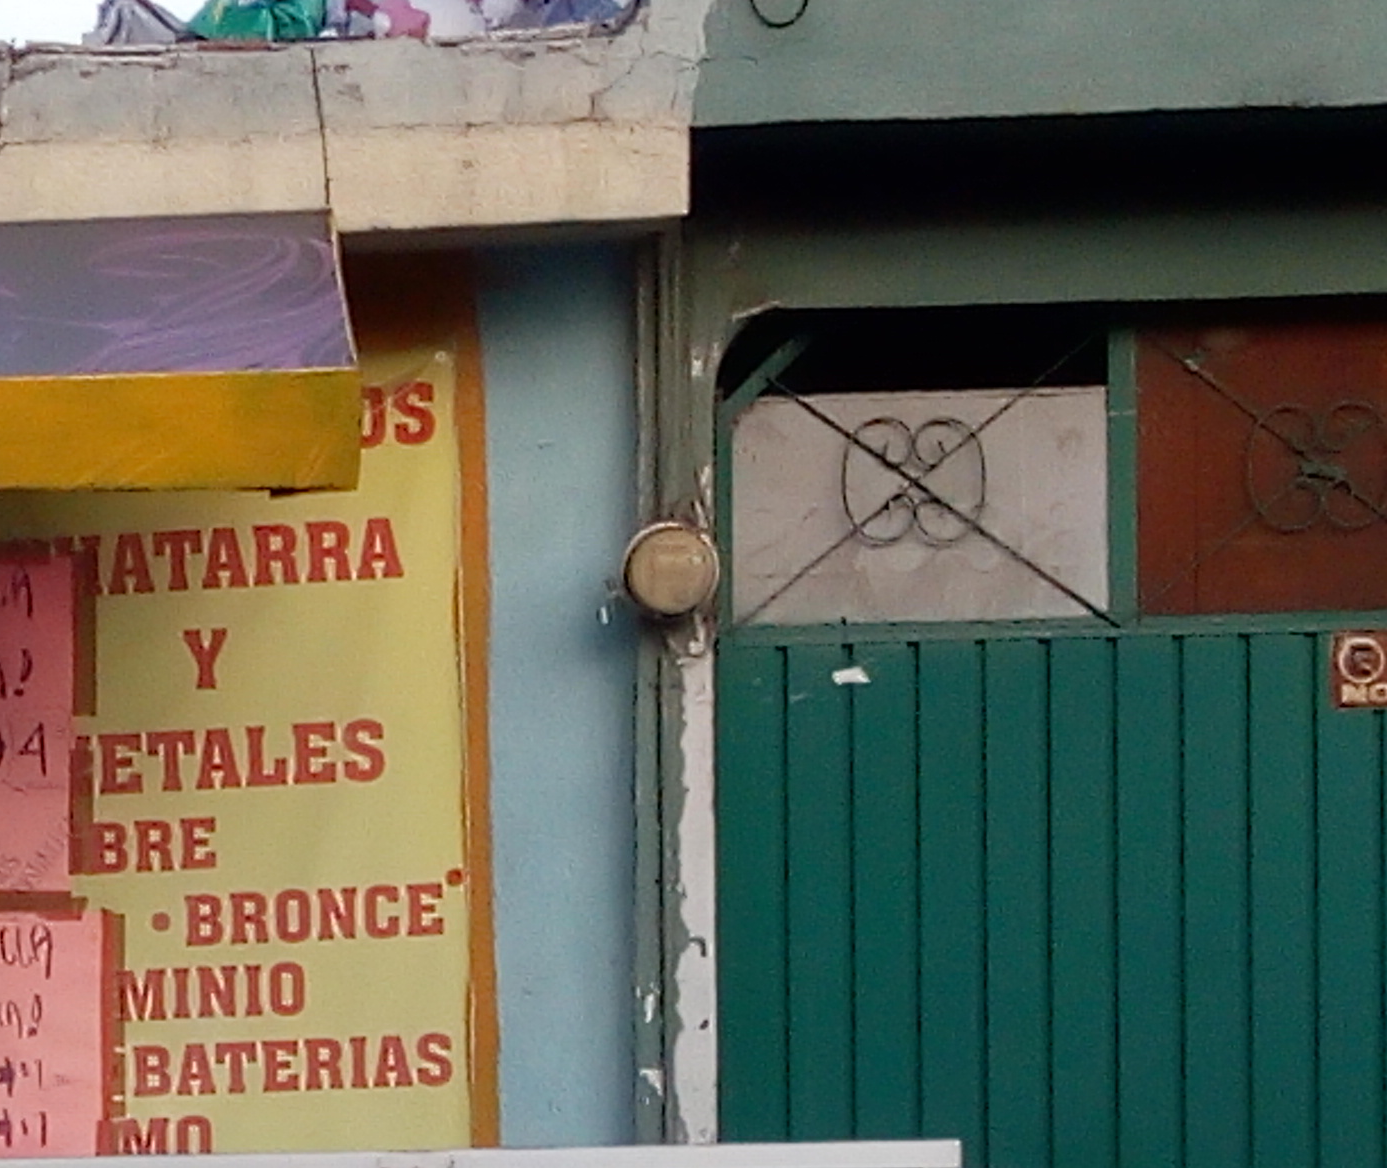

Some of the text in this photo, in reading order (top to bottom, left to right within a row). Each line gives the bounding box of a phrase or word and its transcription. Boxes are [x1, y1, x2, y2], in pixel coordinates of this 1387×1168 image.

[182, 627, 228, 690] Y
[184, 882, 445, 947] BRONCE
[133, 1032, 454, 1098] BATERIAS
